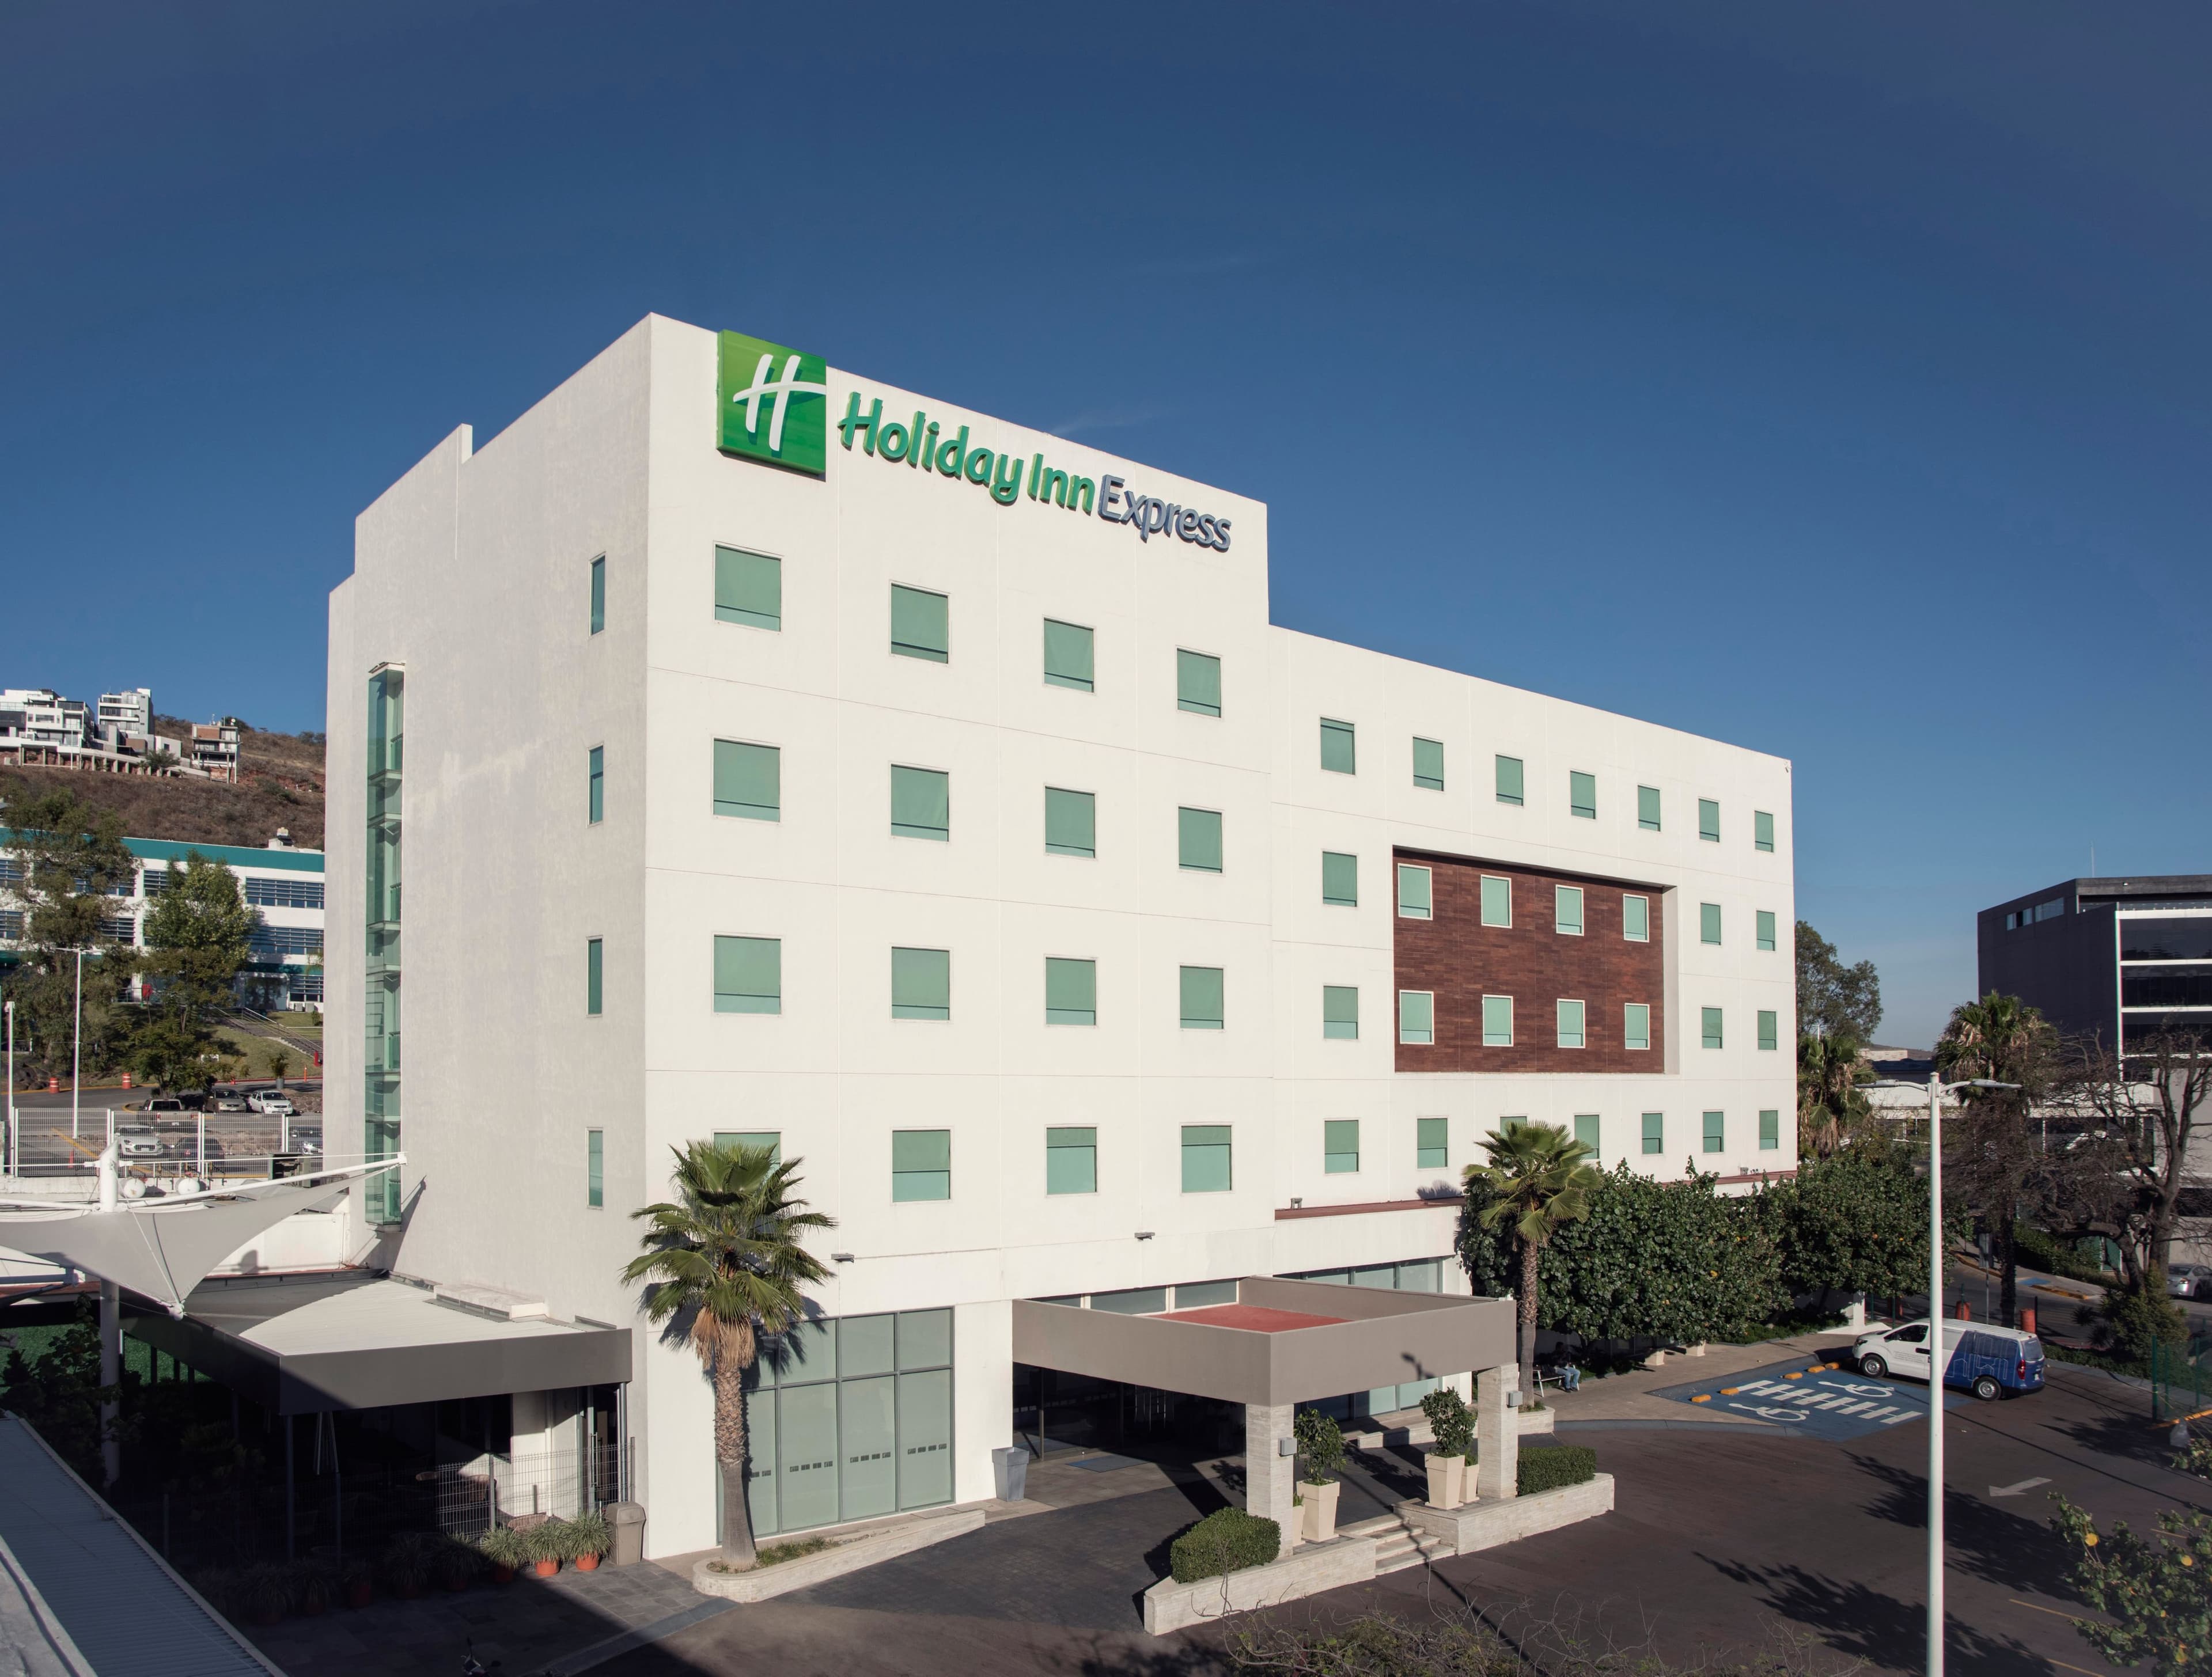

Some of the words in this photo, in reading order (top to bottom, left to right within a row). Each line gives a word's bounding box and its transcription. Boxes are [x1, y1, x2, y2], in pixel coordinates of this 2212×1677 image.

[837, 392, 1024, 504] Holiday
[1027, 453, 1096, 515] Inn
[1098, 474, 1232, 552] Express
